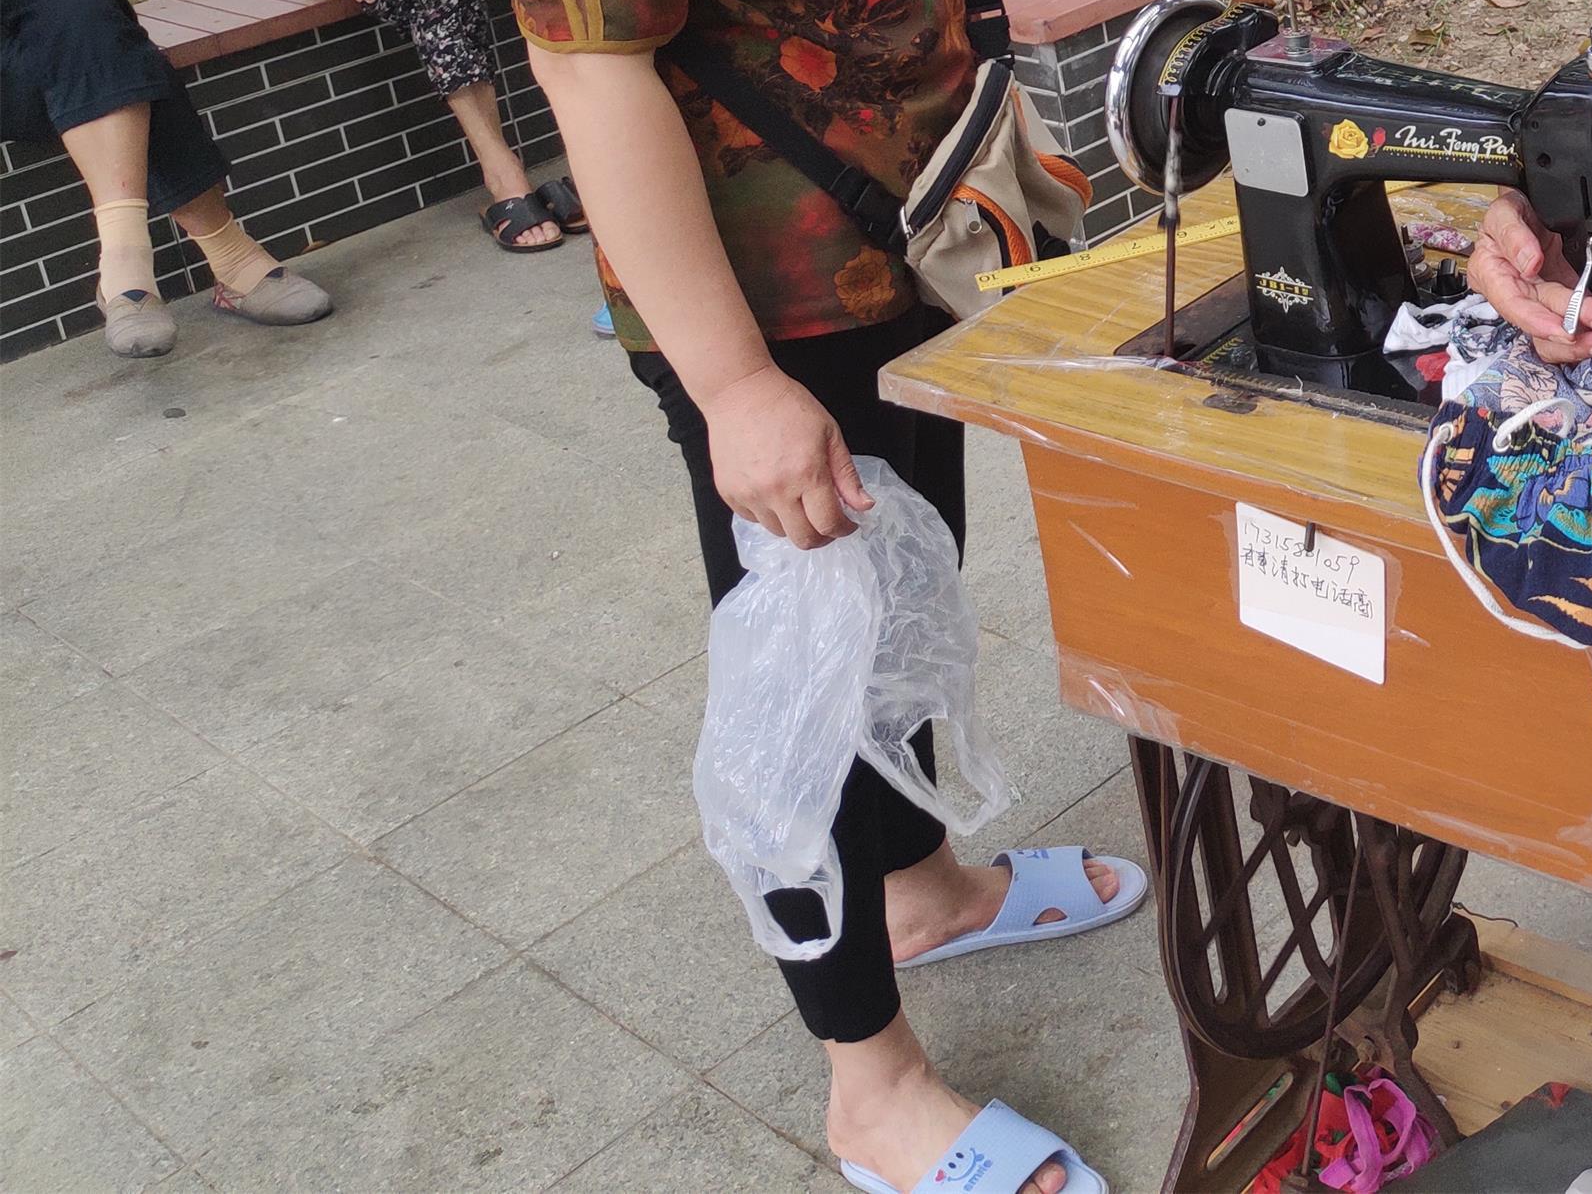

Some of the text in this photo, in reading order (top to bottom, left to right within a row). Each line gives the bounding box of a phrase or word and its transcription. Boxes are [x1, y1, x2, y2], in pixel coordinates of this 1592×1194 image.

[1439, 127, 1481, 162] Feng
[1480, 135, 1518, 160] Pai
[978, 273, 998, 283] 10
